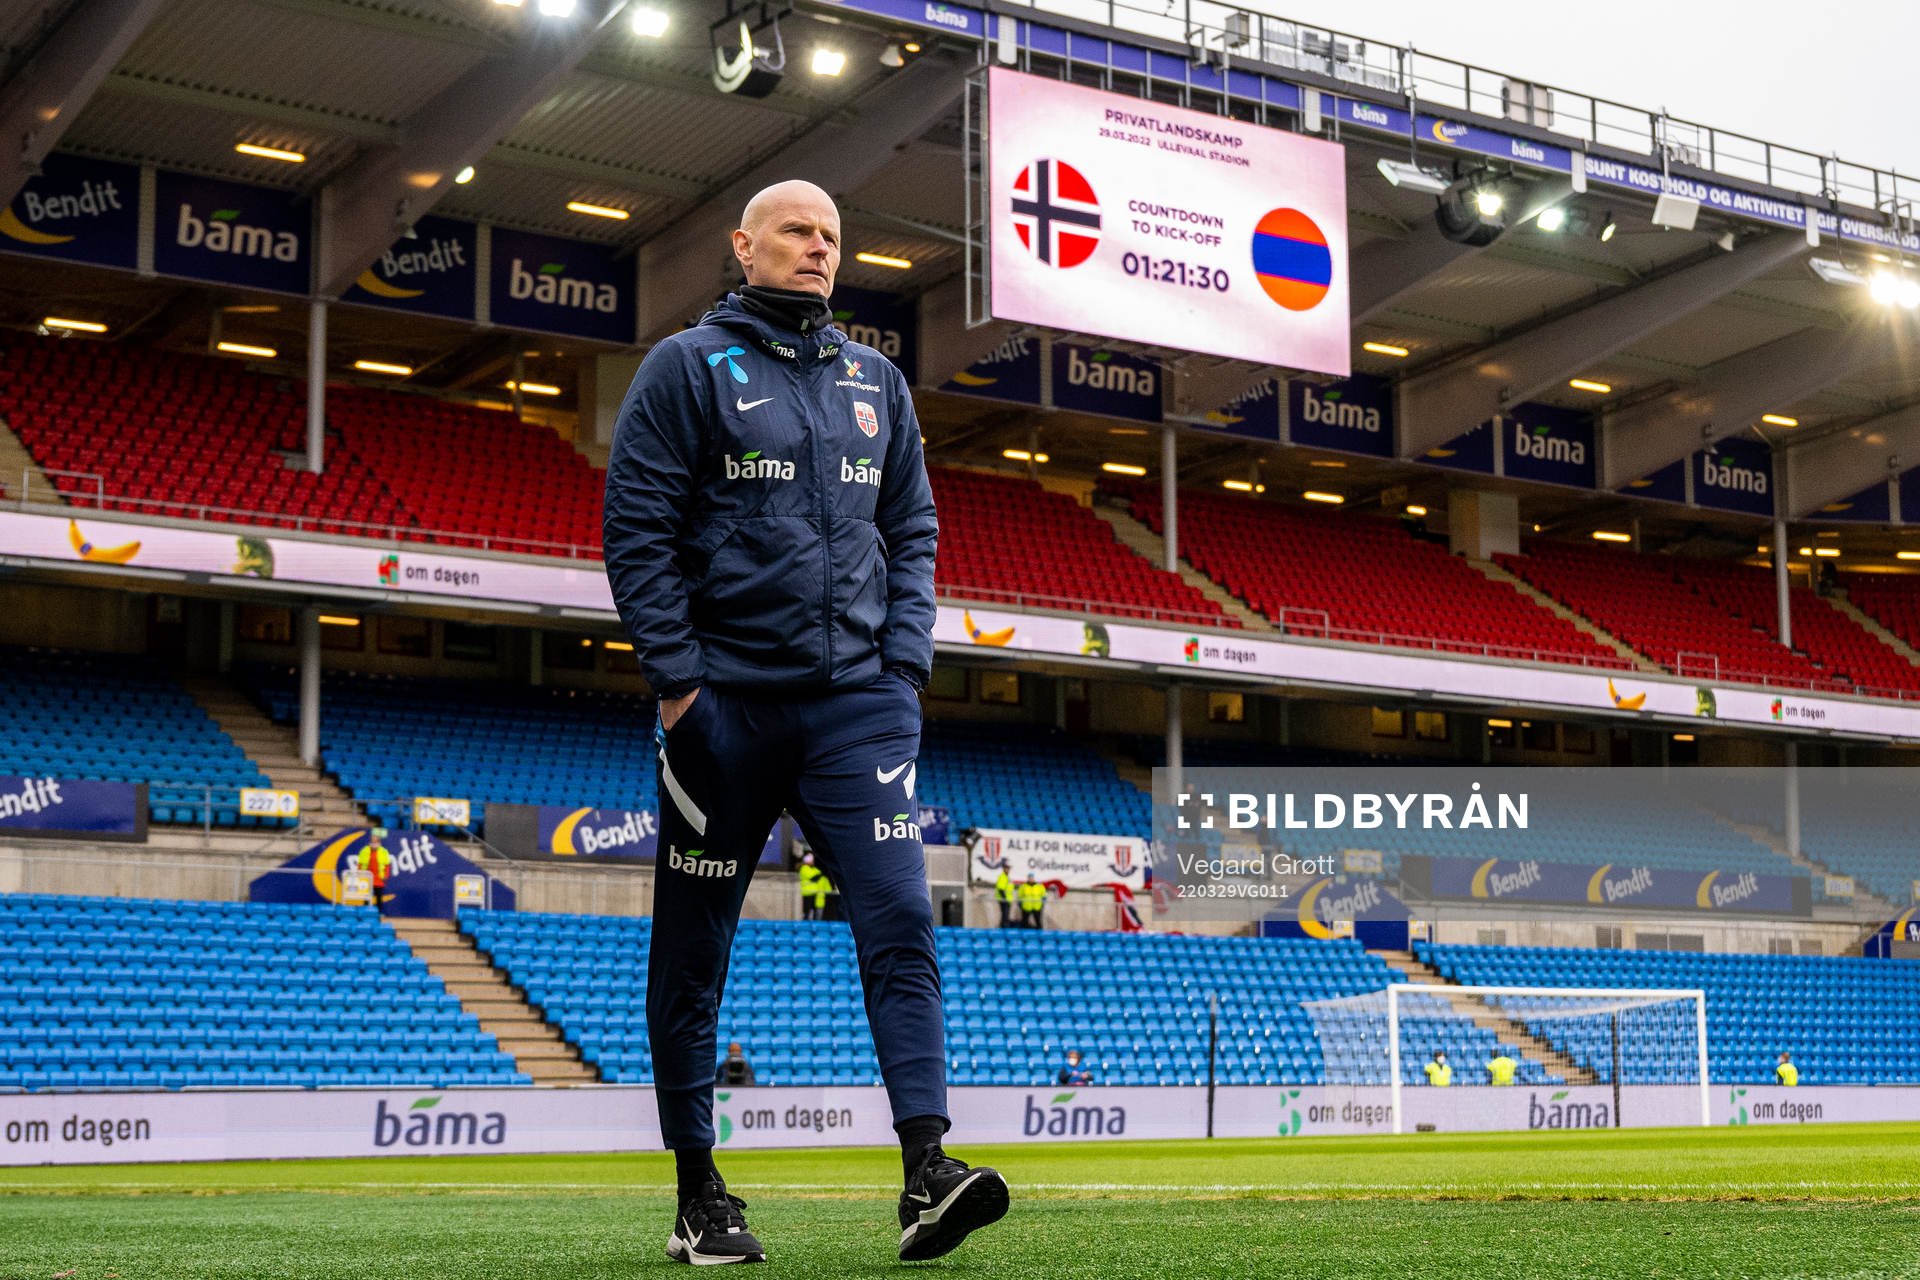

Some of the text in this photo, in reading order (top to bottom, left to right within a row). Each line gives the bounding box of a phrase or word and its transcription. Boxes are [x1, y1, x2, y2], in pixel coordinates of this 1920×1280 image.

[925, 3, 969, 29] bama
[1104, 108, 1244, 149] PRIVATLANDSKAMP
[1352, 103, 1388, 125] bama
[1099, 127, 1251, 168] 29.03.2022 ULLEVAAL STADION
[1511, 139, 1545, 162] bama
[24, 179, 123, 222] Bendit
[1128, 199, 1224, 230] COUNTDOWN
[1629, 168, 1708, 201] KOSTHOLD
[1710, 190, 1732, 208] OG
[1733, 192, 1805, 224] AKTIVITET
[177, 203, 299, 263] bama
[1131, 219, 1222, 248] TO KICK-OFF
[381, 238, 467, 278] Bendit
[1122, 251, 1230, 293] 01:21:30
[510, 258, 618, 314] bama
[1067, 348, 1155, 396] bama
[1303, 386, 1381, 433] bama
[1514, 422, 1586, 465] bama
[724, 454, 796, 481] bama
[1702, 454, 1768, 495] bama
[405, 566, 480, 586] om dagen
[1202, 646, 1220, 659] om
[1785, 706, 1798, 717] om
[248, 797, 274, 811] 227
[580, 810, 657, 855] Bendit
[1007, 838, 1108, 857] ALT FOR NORGE
[669, 844, 738, 878] bama
[1490, 860, 1541, 897] Bendit
[1320, 880, 1381, 923] Bendit
[1605, 865, 1653, 902] Bendit
[1713, 872, 1759, 907] Bendit
[374, 1099, 507, 1147] bama
[742, 1104, 853, 1132] om dagen
[1024, 1094, 1126, 1136] bama
[1309, 1105, 1334, 1123] om
[1528, 1092, 1609, 1129] bama
[1753, 1100, 1823, 1124] om dagen
[6, 1114, 151, 1146] om dagen
